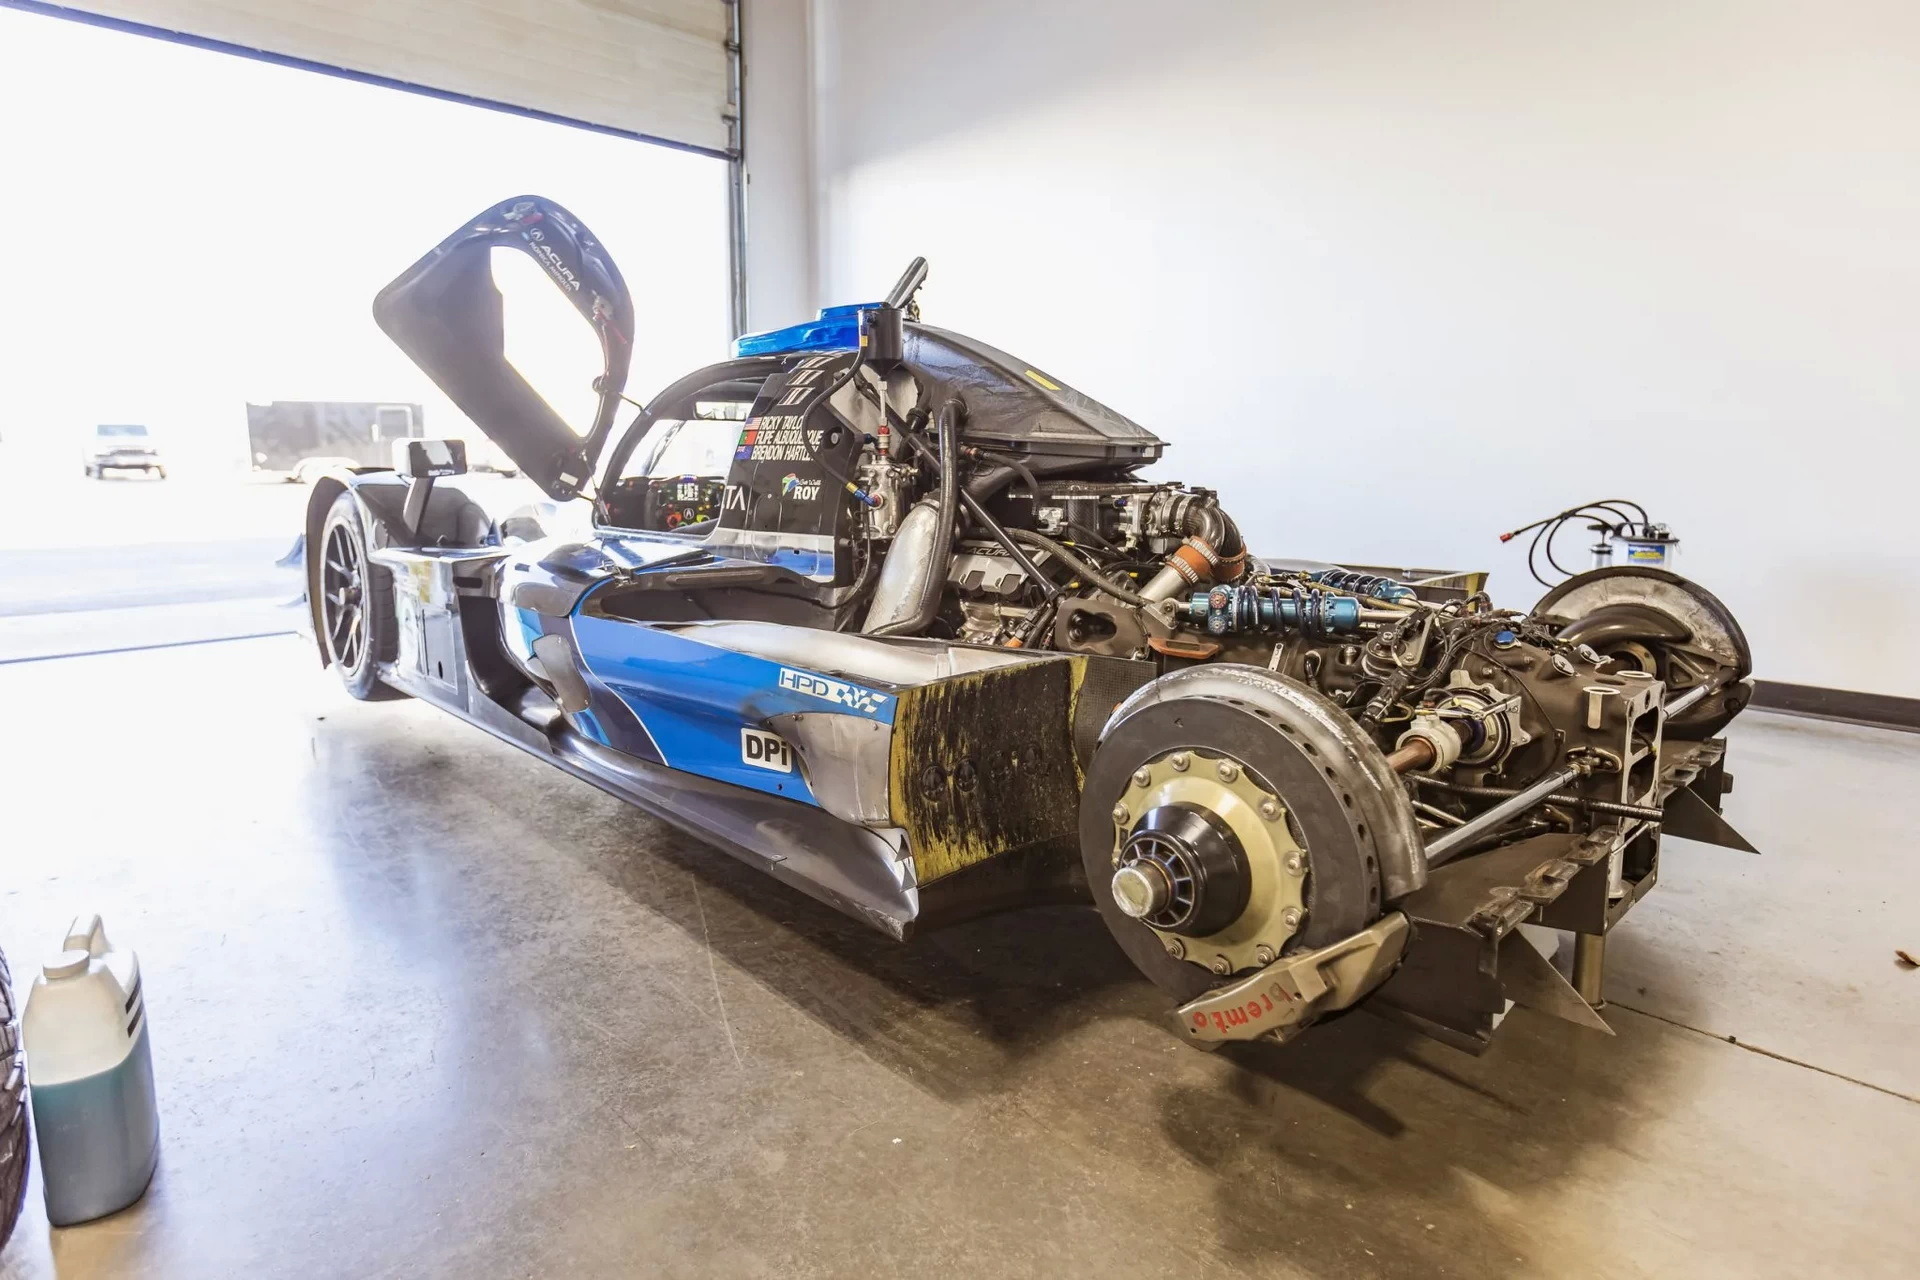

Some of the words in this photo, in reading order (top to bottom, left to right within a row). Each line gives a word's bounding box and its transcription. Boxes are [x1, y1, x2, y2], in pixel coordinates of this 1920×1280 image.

[540, 245, 580, 291] ACURA
[760, 416, 783, 430] RICKY
[781, 415, 804, 430] TAYLO
[754, 430, 775, 445] FILIPE
[751, 445, 785, 460] BRENDON
[793, 485, 820, 500] ROY
[780, 670, 829, 697] HPD
[745, 733, 788, 767] DPi
